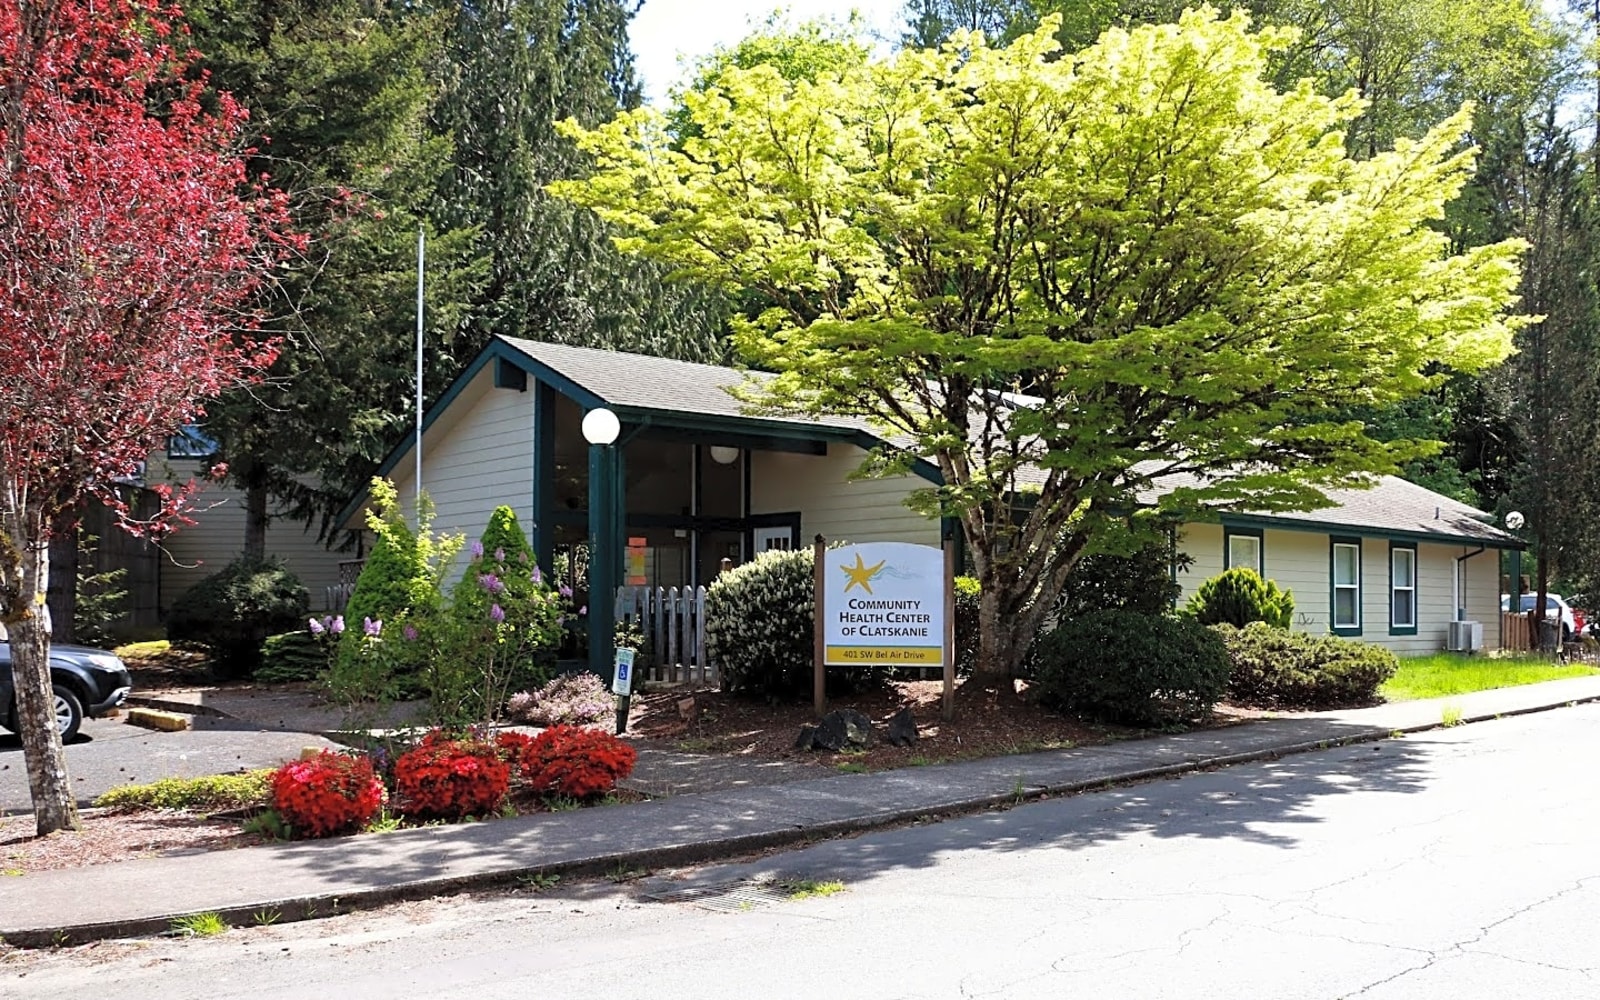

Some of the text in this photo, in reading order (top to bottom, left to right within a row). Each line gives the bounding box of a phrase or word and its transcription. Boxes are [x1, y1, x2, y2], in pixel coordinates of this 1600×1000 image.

[848, 599, 921, 610] COMMUNITY
[840, 612, 930, 623] HEALTH CENTER
[841, 625, 928, 637] OF CLATSKANIE
[843, 650, 925, 659] 401 SW Bel Air Drive
